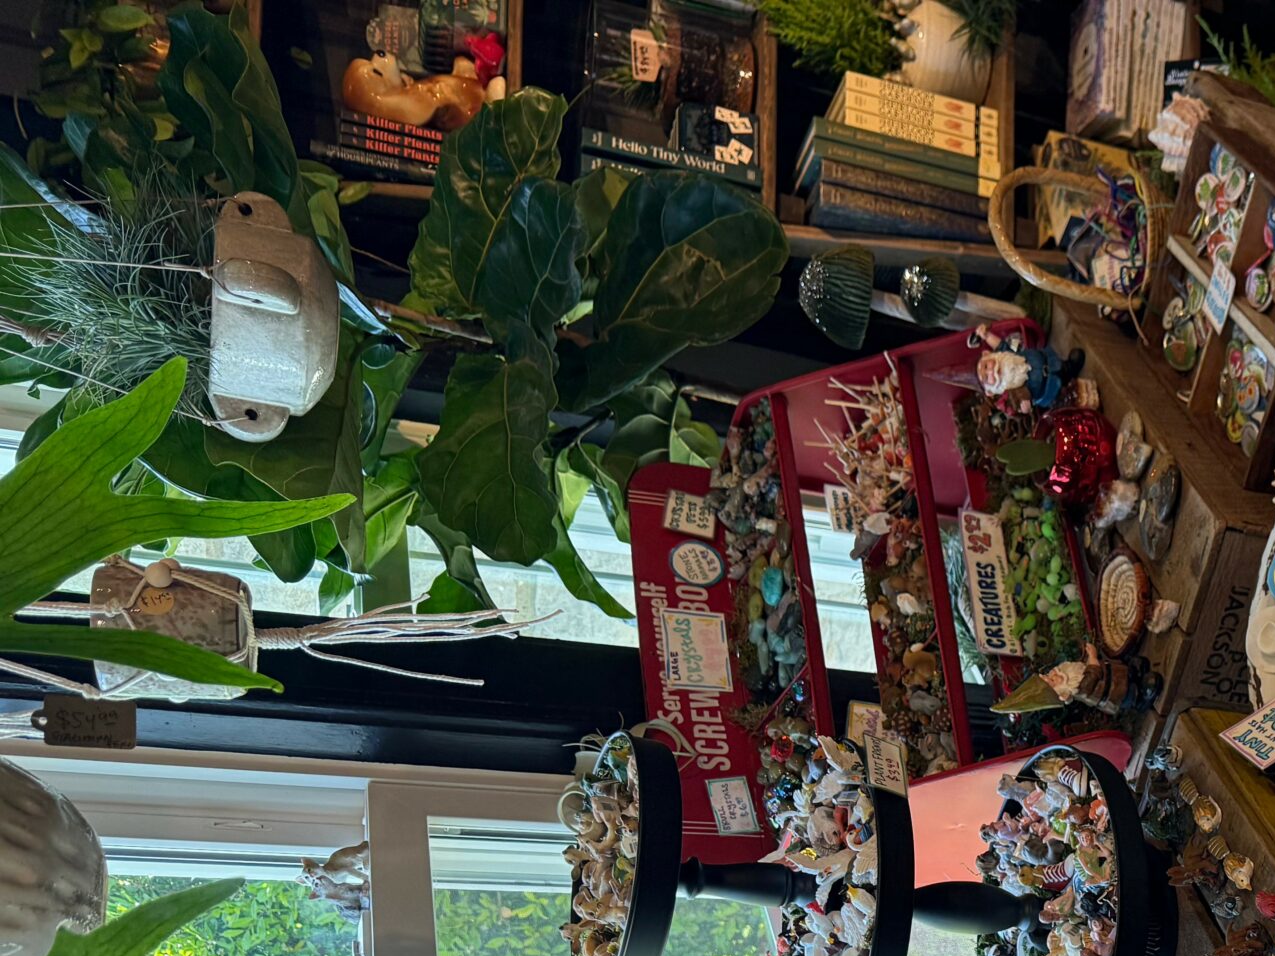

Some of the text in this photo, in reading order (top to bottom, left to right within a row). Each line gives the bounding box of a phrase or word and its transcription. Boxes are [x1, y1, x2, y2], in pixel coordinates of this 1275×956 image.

[366, 115, 443, 140] Killer Plants
[366, 128, 441, 153] Killer Plants
[337, 152, 400, 170] HOUSEPLANTS
[365, 139, 400, 155] Killer
[403, 149, 440, 164] Plants
[611, 136, 726, 174] Hello Tiny World
[679, 551, 699, 580] STONE
[976, 561, 1007, 650] CREATURES
[1200, 584, 1250, 687] JACKSON
[670, 651, 681, 680] LARGE
[688, 692, 731, 771] SCREW
[1248, 719, 1268, 735] HATS
[1233, 728, 1271, 761] TINY
[873, 763, 887, 787] PLANT
